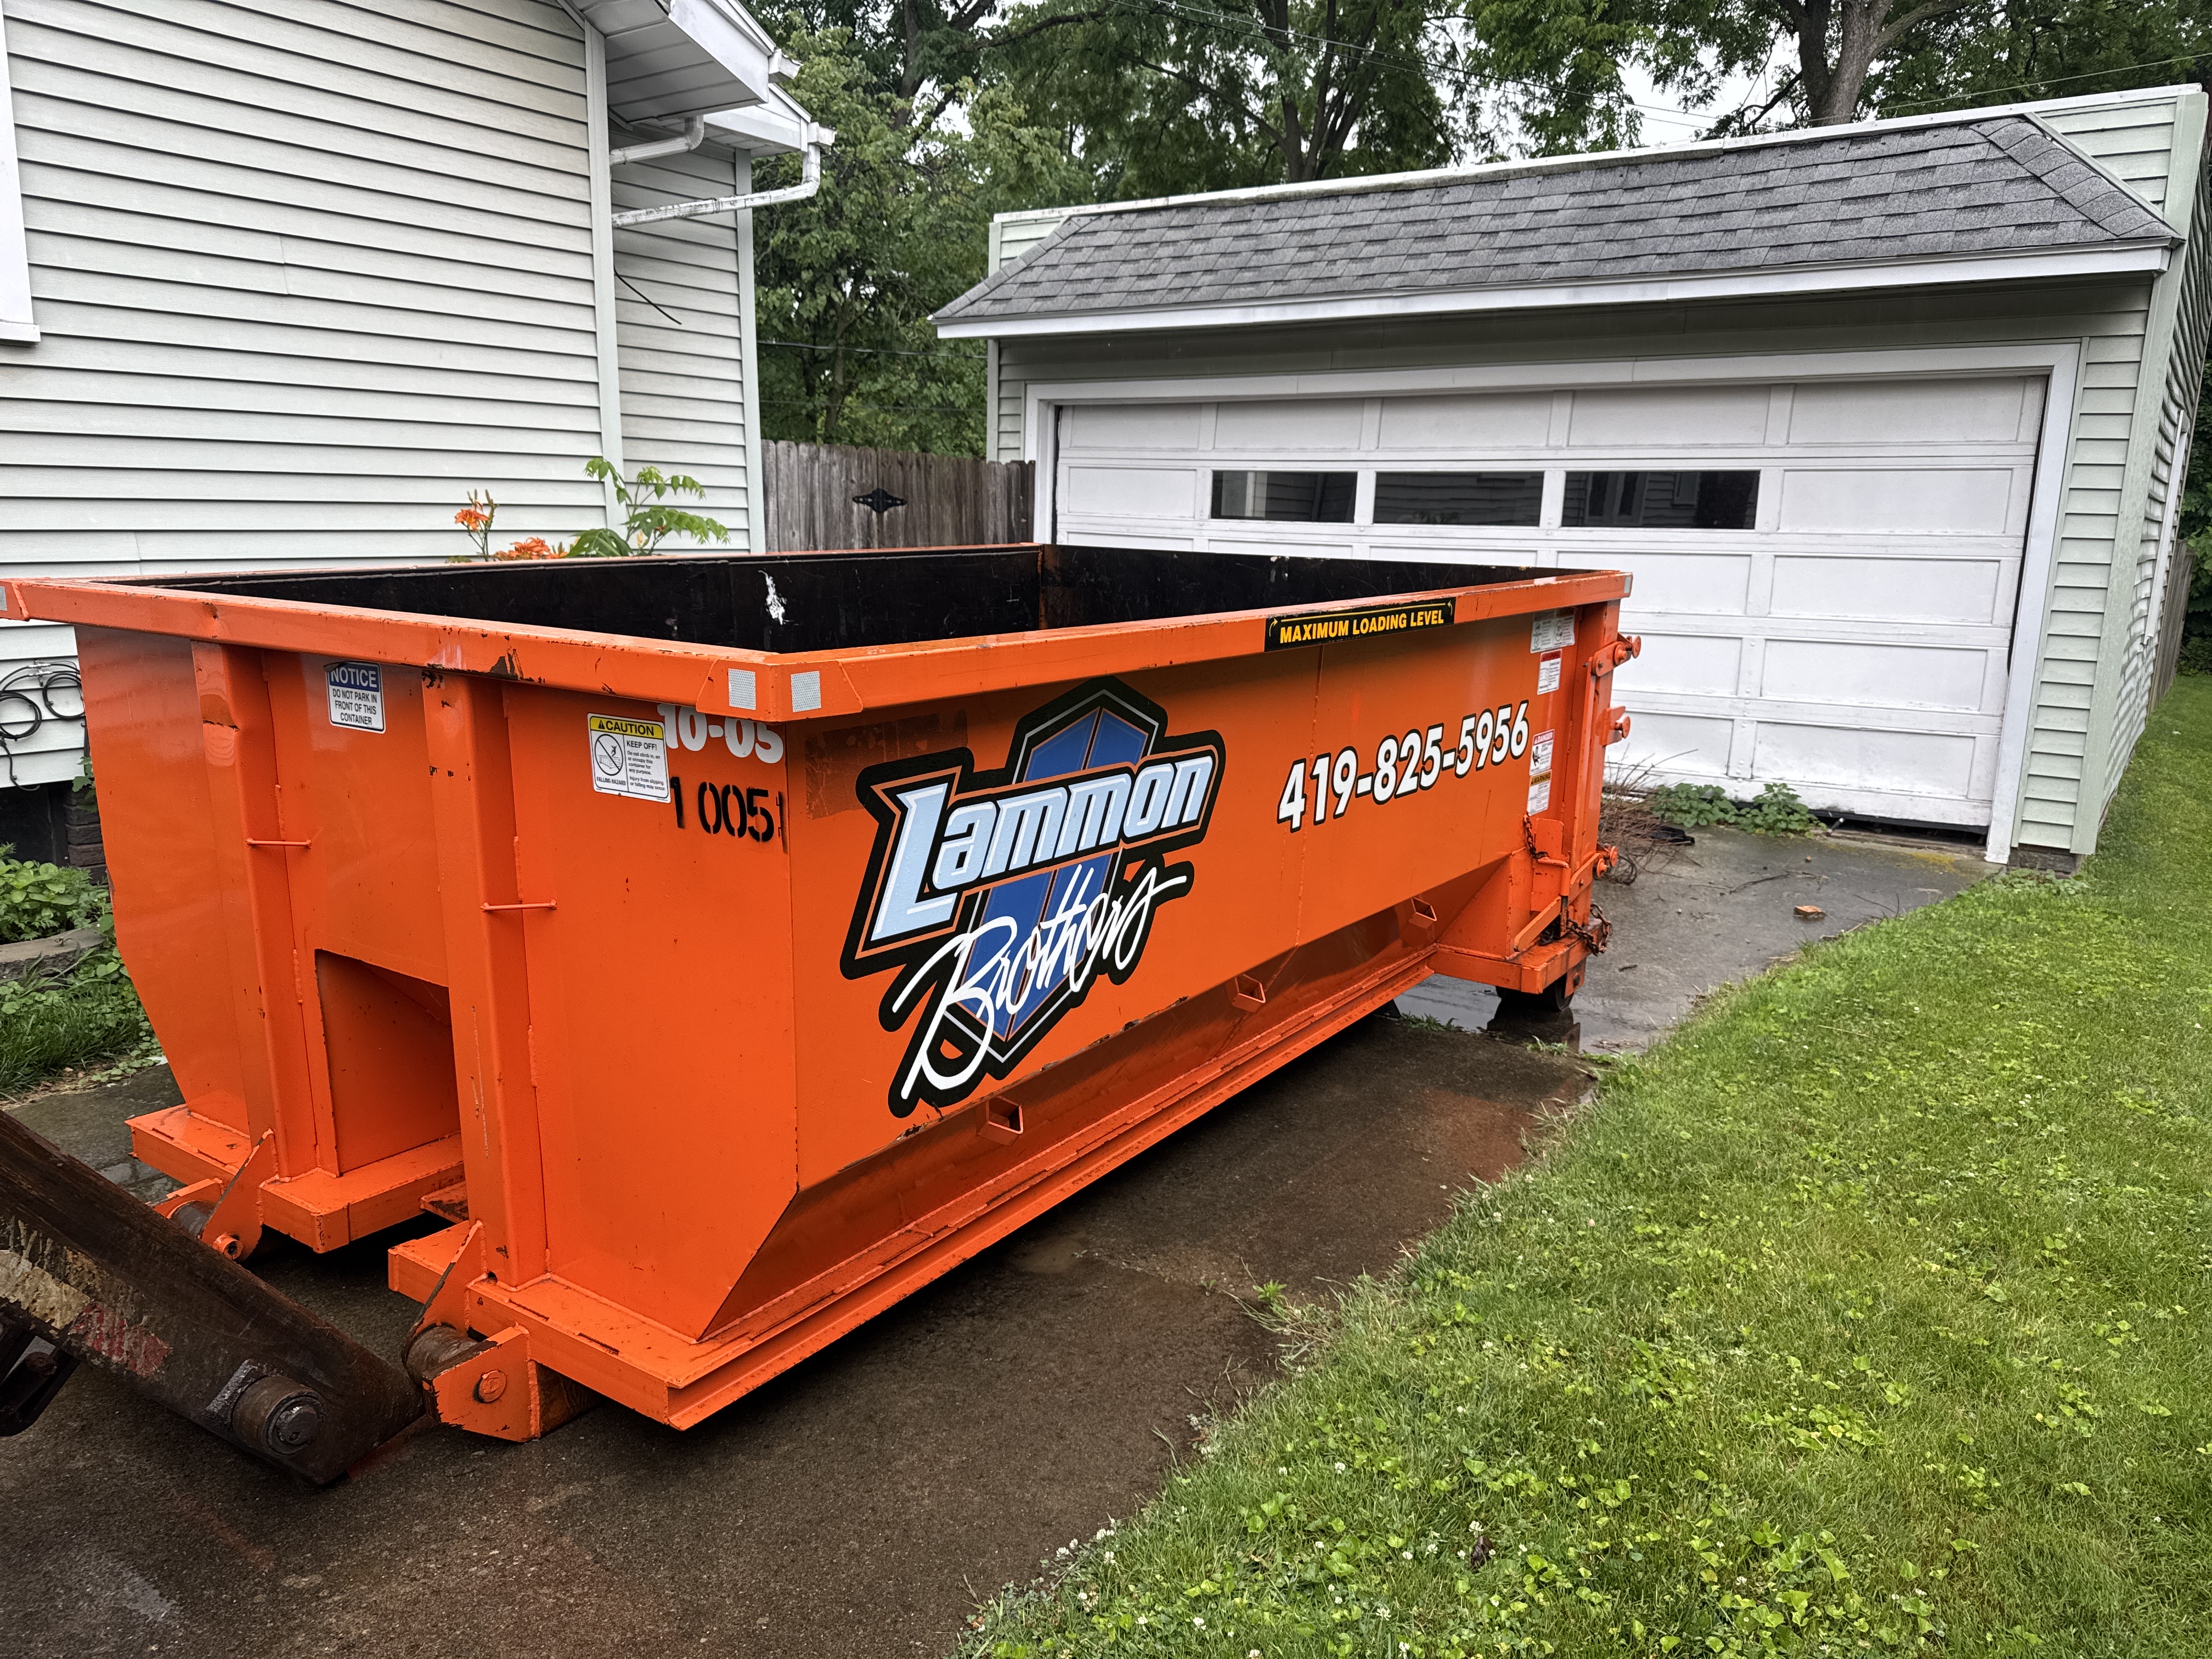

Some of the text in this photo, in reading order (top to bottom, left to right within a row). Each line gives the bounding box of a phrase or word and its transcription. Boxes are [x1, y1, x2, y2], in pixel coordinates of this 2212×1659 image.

[1279, 610, 1444, 644] MAXIMUM LOADING LEVEL
[331, 667, 377, 688] NOTICE
[332, 689, 377, 703] DO NOT PARK IN
[335, 700, 377, 715] FRONT OF THIS
[340, 712, 373, 726] CONTAINER
[606, 720, 654, 736] CAUTION
[657, 703, 783, 764] 10-05
[627, 740, 657, 751] KEEP OFF!
[1277, 699, 1529, 833] 419-825-5956
[1533, 772, 1551, 783] WARNING
[871, 755, 1212, 942] Lammon
[892, 864, 1187, 1100] Brothers
